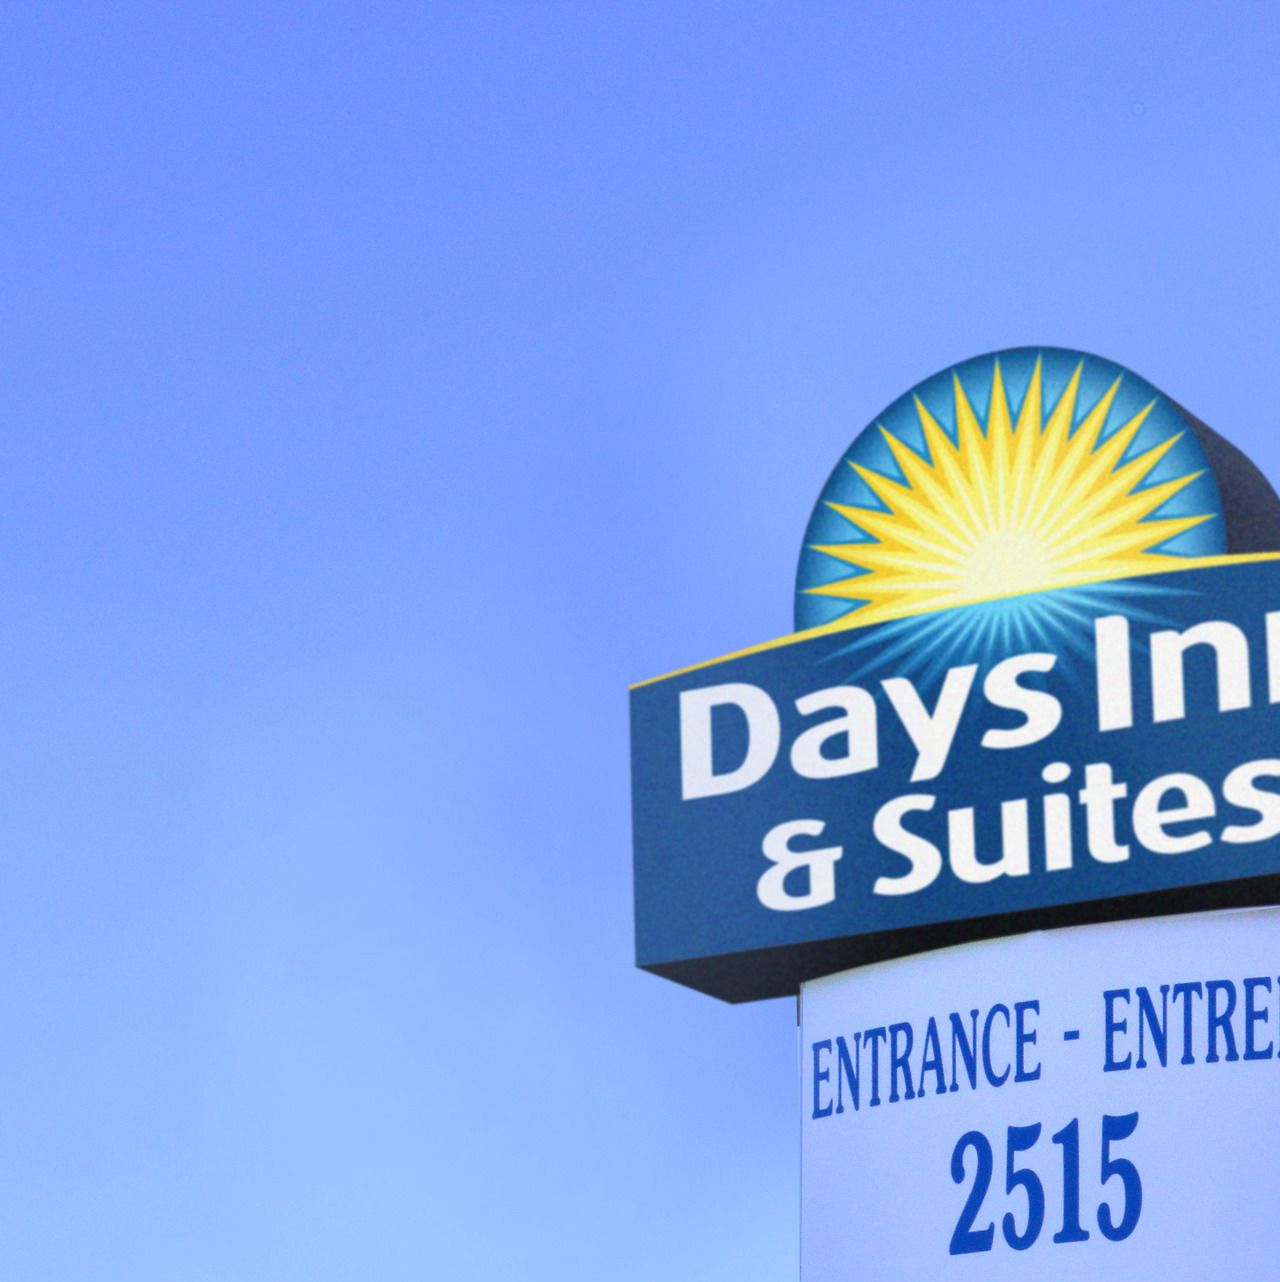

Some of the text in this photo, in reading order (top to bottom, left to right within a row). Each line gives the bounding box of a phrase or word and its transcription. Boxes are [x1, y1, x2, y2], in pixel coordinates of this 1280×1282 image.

[679, 652, 1063, 801] Days
[756, 819, 843, 911] &
[812, 1000, 1041, 1120] ENTRANCE
[948, 1111, 1144, 1256] 2515
